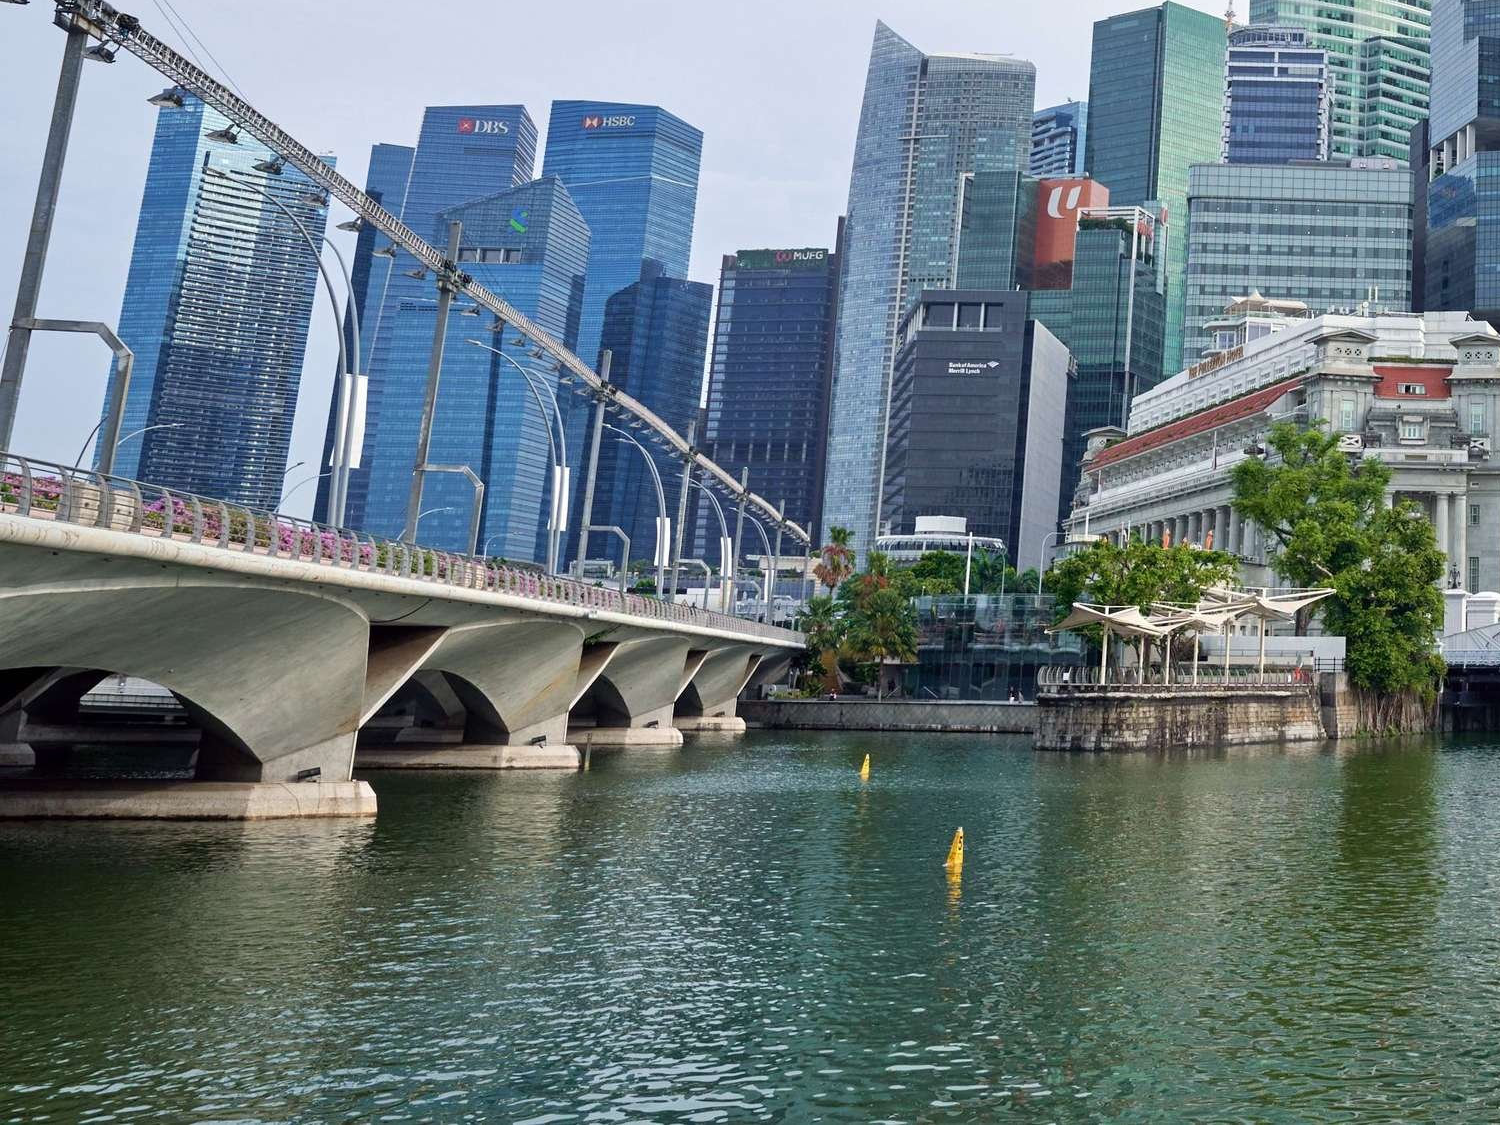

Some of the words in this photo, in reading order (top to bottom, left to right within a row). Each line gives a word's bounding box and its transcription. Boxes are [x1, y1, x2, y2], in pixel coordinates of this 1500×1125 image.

[603, 115, 636, 126] HSBC
[474, 120, 509, 134] DBS
[793, 251, 823, 260] MUFG
